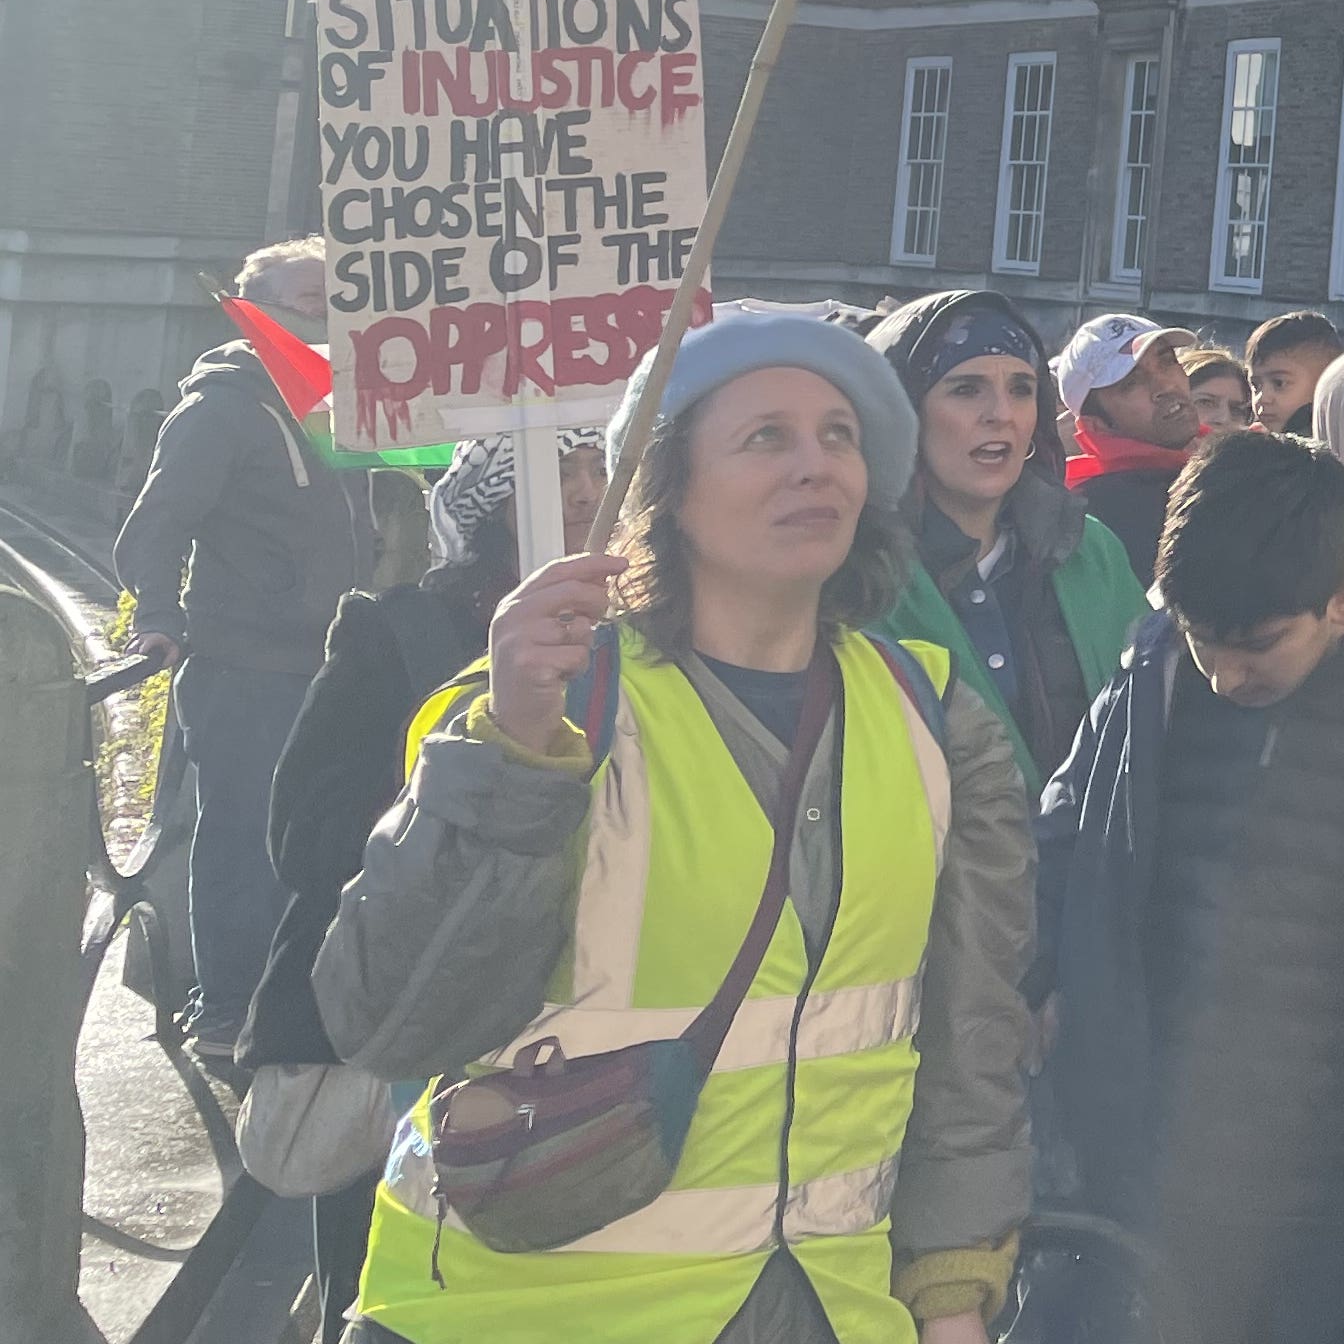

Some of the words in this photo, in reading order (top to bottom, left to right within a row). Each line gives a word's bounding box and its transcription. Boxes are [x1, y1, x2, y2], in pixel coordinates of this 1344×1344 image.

[321, 51, 393, 111] OF
[402, 45, 701, 121] INJUSTICE
[322, 121, 430, 185] YOU
[450, 108, 593, 184] HAVE
[329, 246, 470, 313] SIDE
[489, 233, 582, 294] OF
[601, 226, 700, 285] THE
